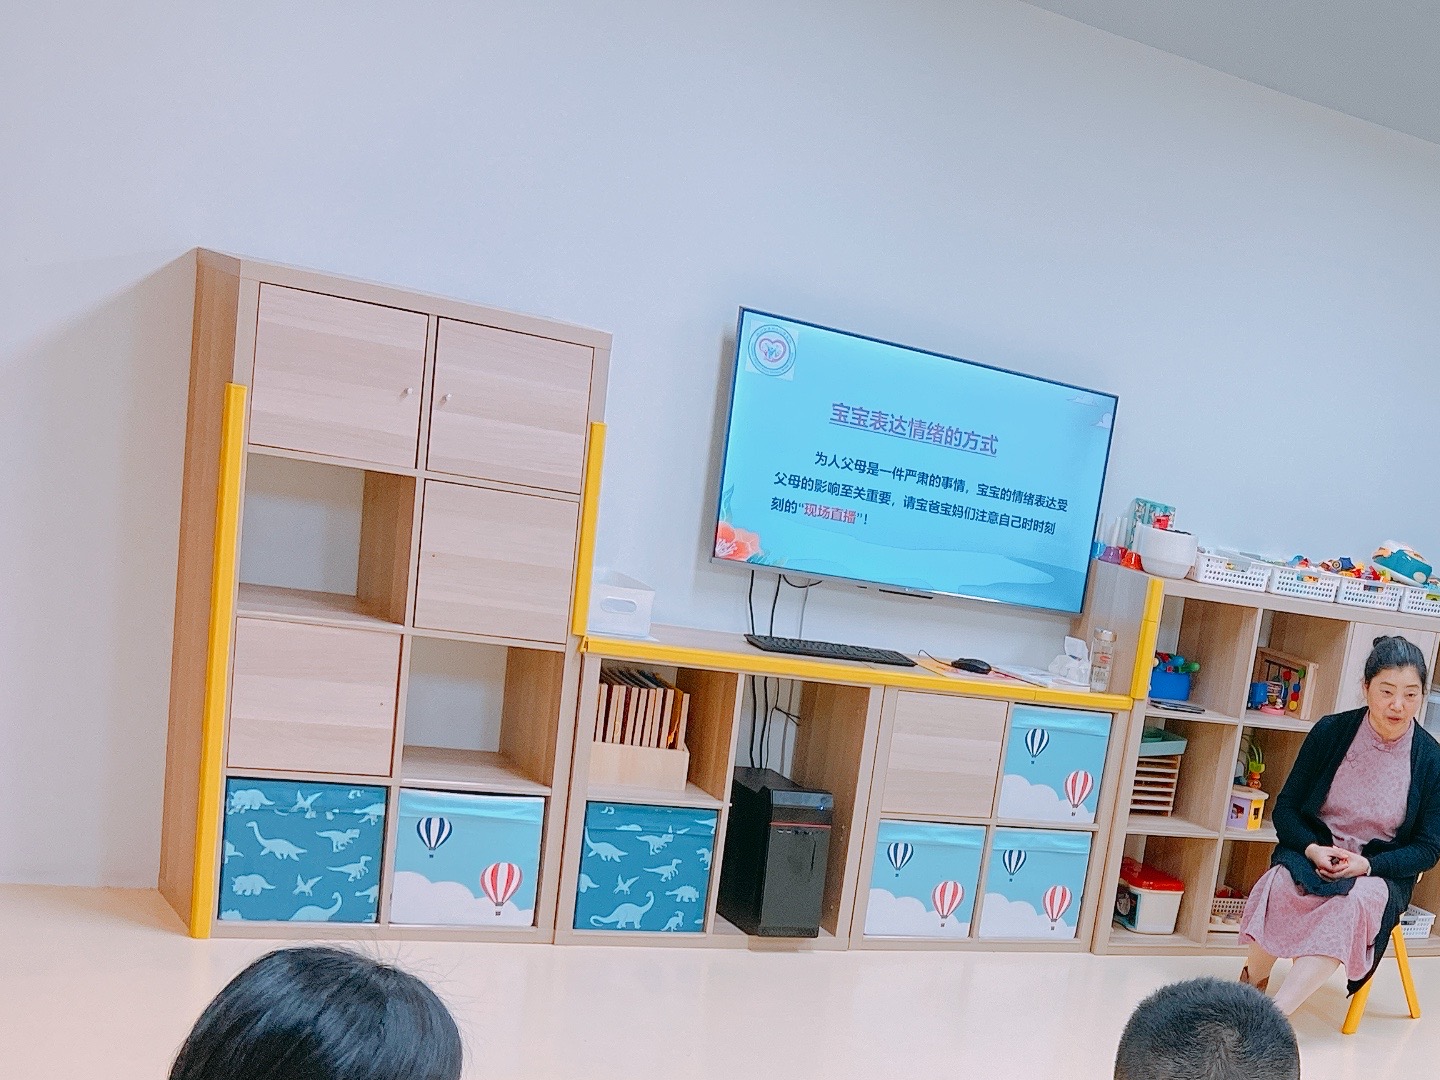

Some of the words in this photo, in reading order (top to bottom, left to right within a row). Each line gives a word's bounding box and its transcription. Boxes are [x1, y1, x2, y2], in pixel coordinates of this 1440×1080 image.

[830, 402, 999, 457] 宝宝表达情绪的方式
[774, 471, 1056, 535] 父母的影响至关重要，请宝爸宝妈们注意自己时时刻
[815, 451, 1069, 512] 为人父母是一件严肃的事情，宝宝的情绪表达受
